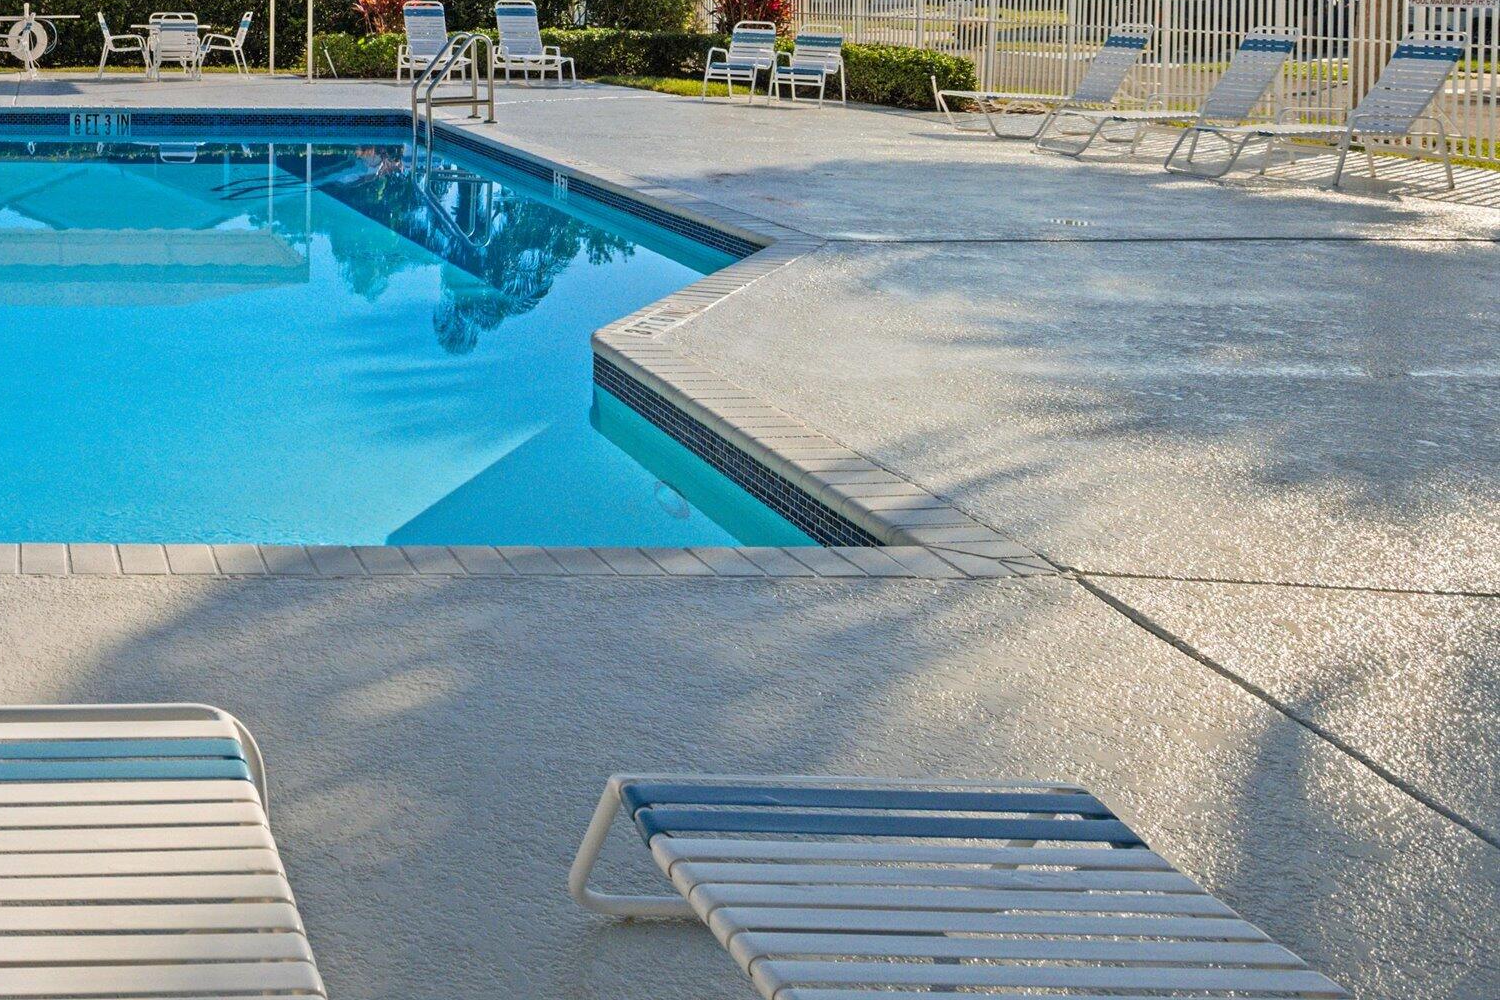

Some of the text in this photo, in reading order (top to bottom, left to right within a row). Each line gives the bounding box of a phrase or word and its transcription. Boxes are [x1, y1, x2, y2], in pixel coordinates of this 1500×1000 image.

[74, 114, 129, 126] 6 FT 3 IN
